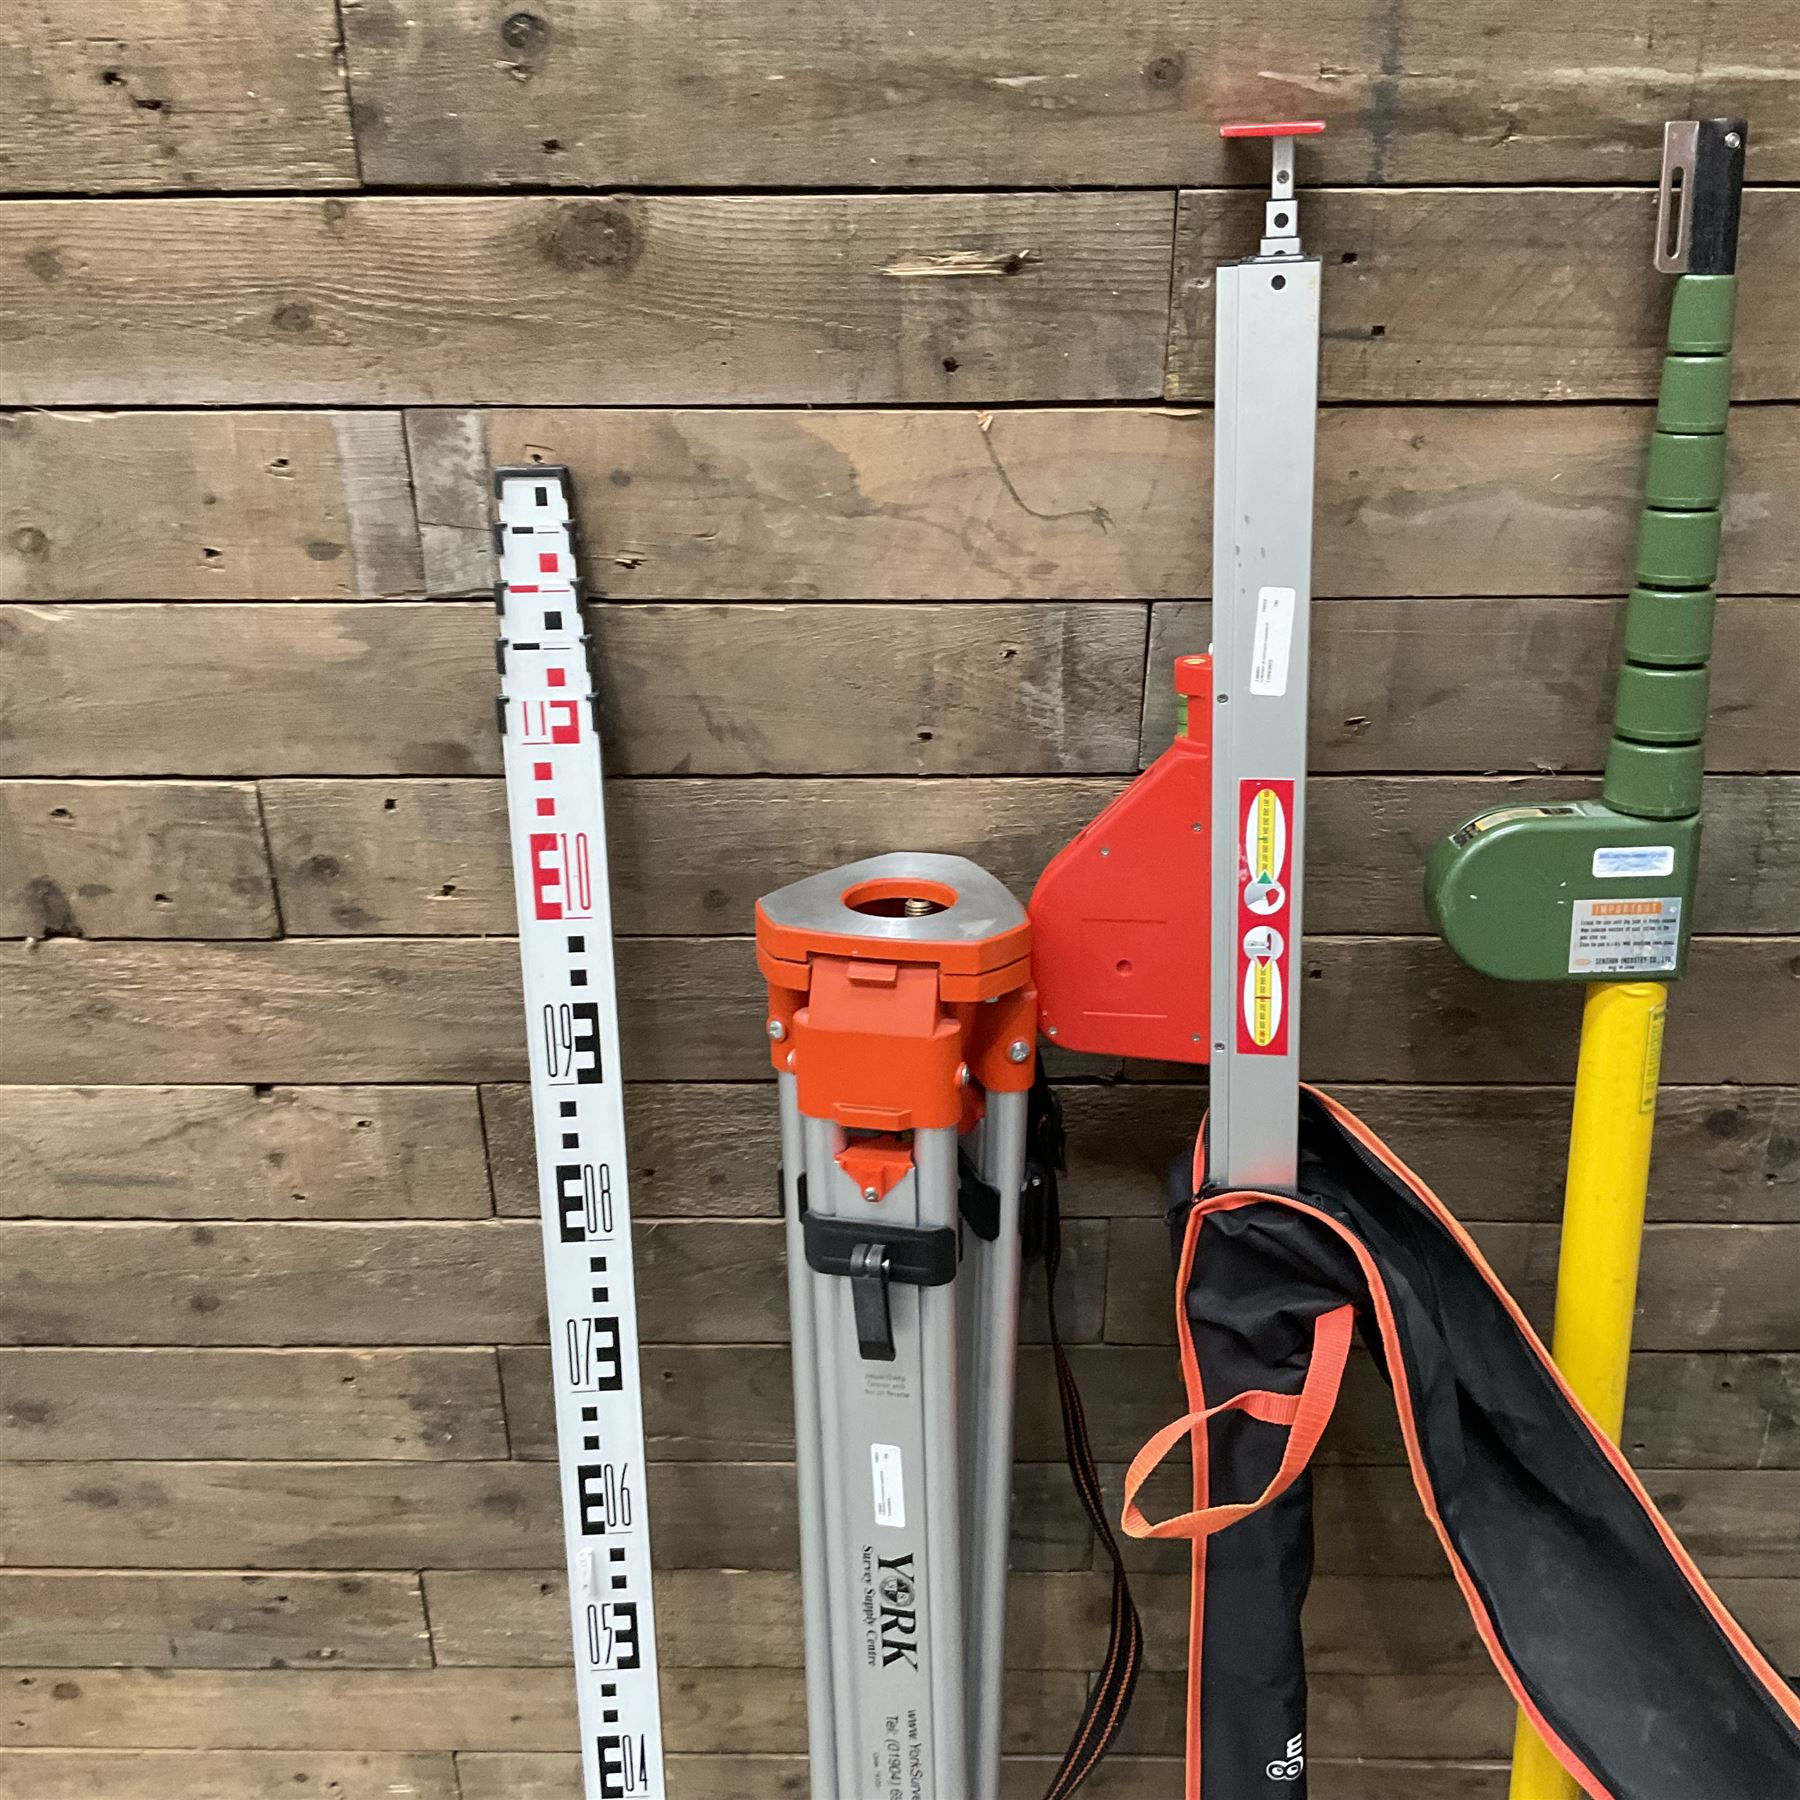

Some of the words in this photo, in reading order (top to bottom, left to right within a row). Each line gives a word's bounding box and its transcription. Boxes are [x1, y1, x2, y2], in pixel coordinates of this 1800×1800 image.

[543, 1003, 573, 1078] 09
[583, 1163, 613, 1234] 08
[567, 1318, 592, 1386] 07
[604, 1462, 632, 1528] 06
[861, 1544, 874, 1585] Survey
[587, 1603, 613, 1665] 05
[862, 1587, 877, 1629] Supply
[878, 1552, 919, 1673] YORK
[865, 1630, 877, 1668] Centre
[884, 1738, 902, 1786] (01904)
[1265, 1732, 1304, 1781] 8m
